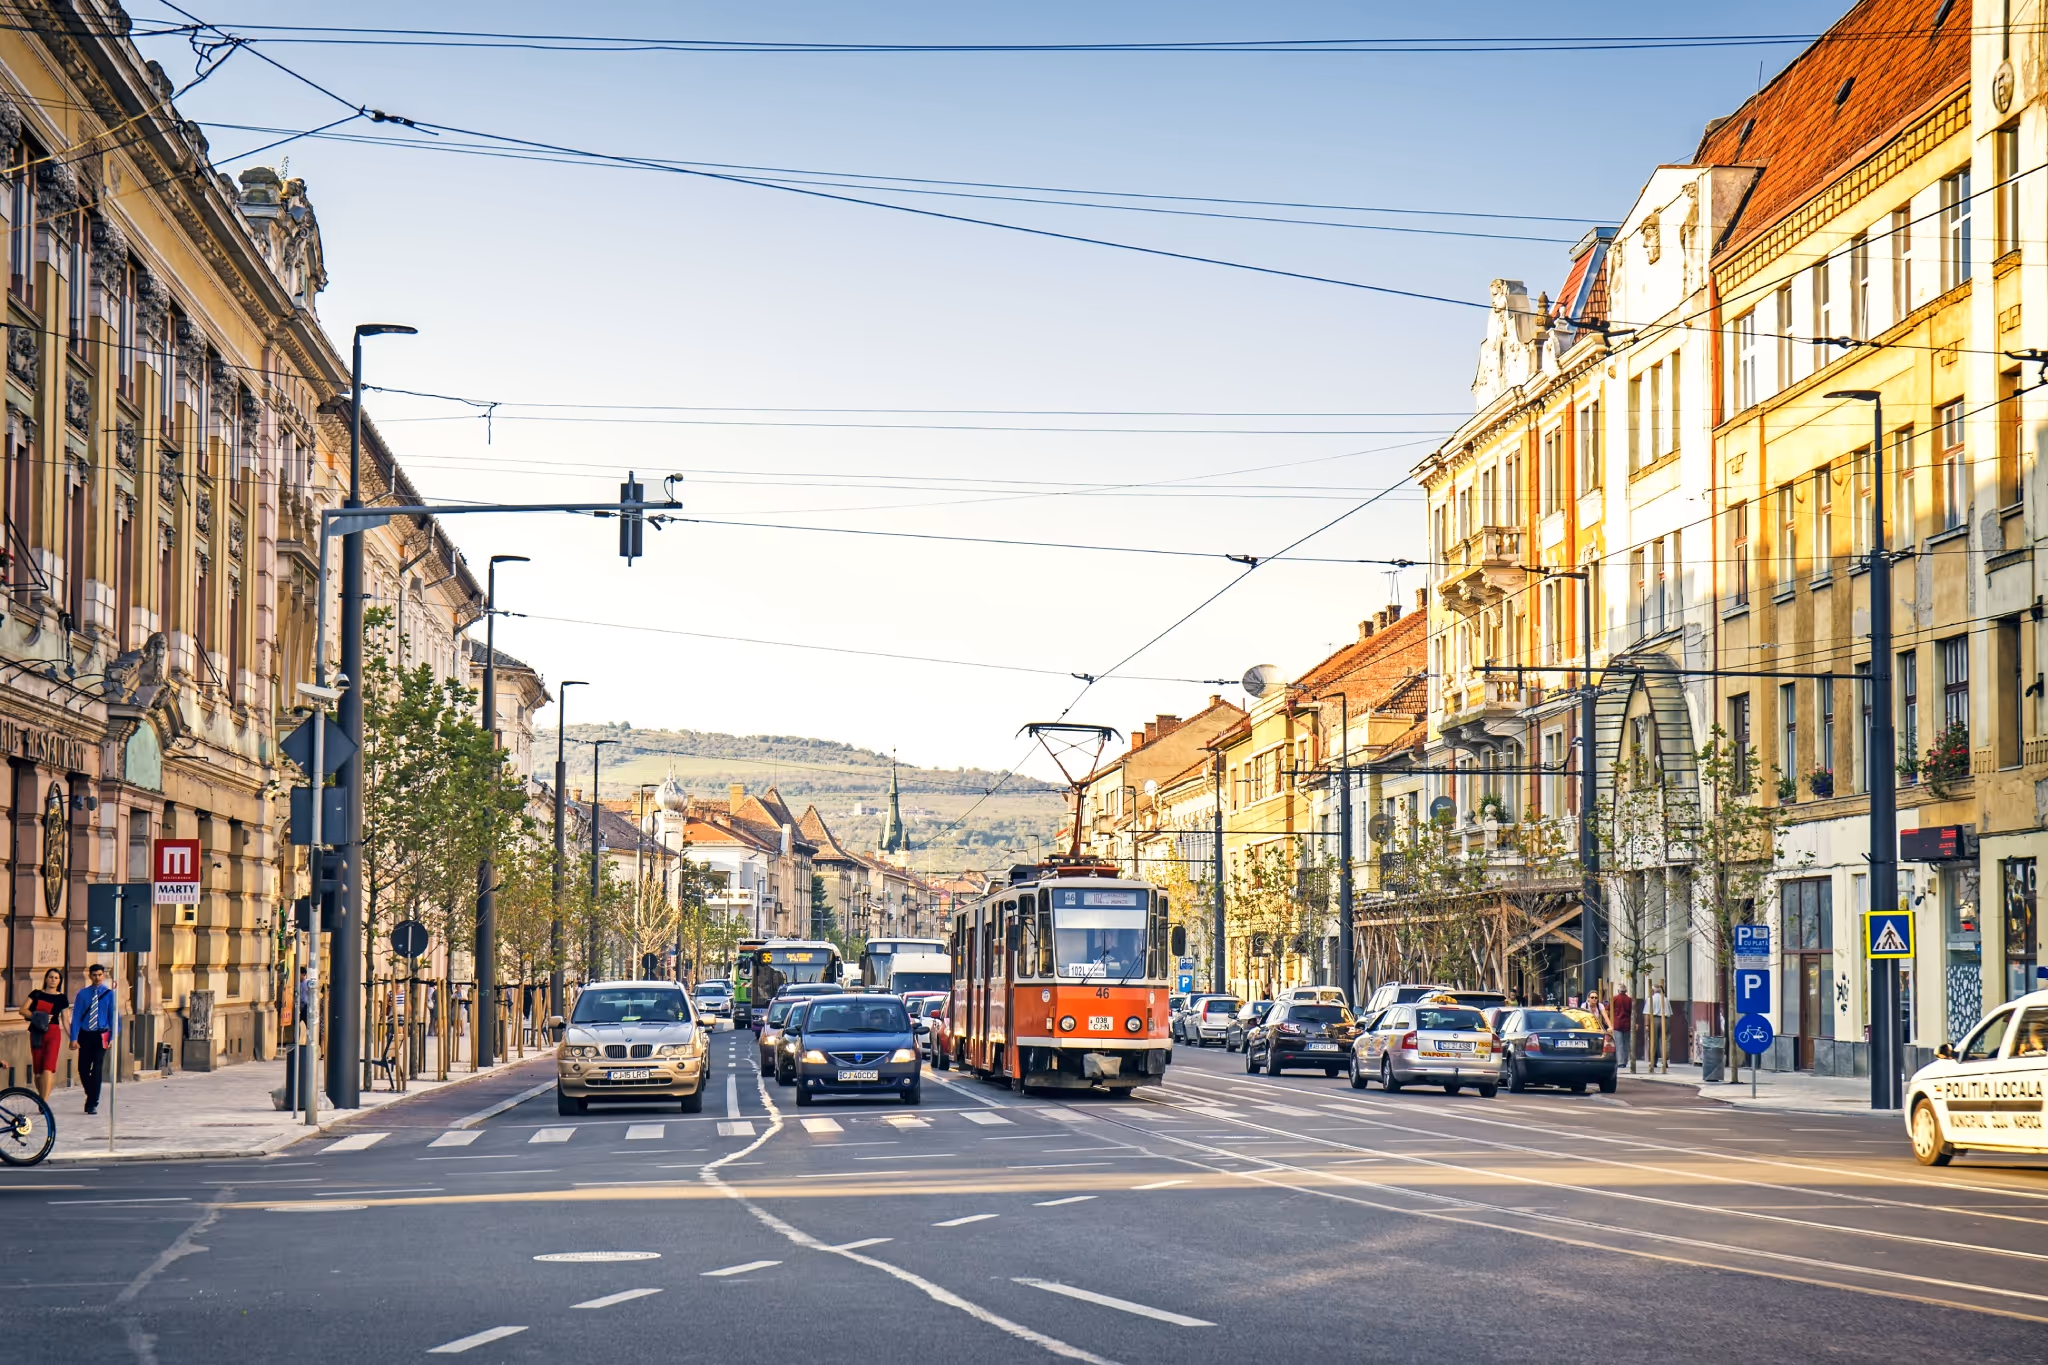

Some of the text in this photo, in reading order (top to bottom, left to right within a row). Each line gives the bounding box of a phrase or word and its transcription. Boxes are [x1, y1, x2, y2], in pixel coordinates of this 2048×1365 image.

[158, 885, 195, 894] MARTY
[1738, 927, 1751, 945] P
[762, 952, 772, 963] 35
[1071, 965, 1086, 977] 102L
[1182, 976, 1190, 988] P
[1744, 974, 1762, 999] P
[1095, 987, 1110, 999] 46
[1095, 1016, 1108, 1024] 038
[1946, 1081, 2043, 1098] POLITIA LOCALA
